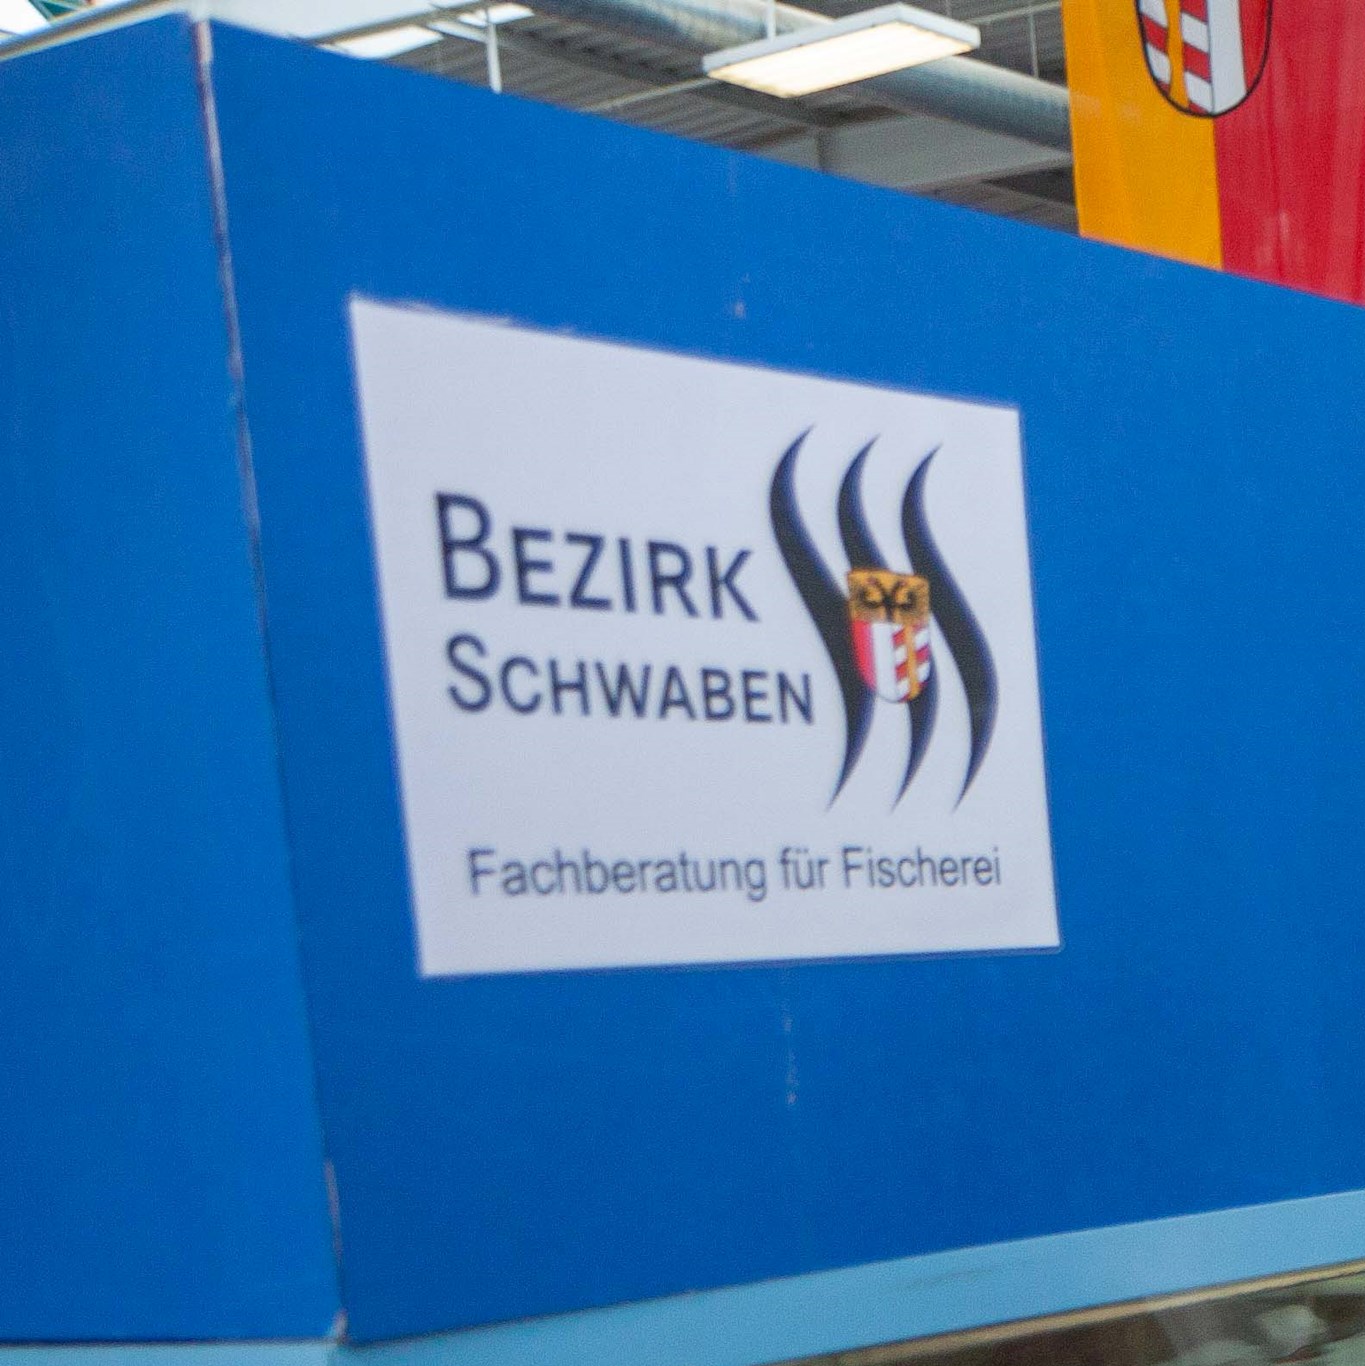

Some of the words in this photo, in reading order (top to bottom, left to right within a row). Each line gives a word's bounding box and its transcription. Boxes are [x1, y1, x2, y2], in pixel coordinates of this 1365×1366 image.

[434, 492, 757, 621] BEZIRK
[446, 633, 814, 724] SCHWABEN
[467, 845, 766, 902] Fachberatung
[780, 846, 827, 890] für
[841, 846, 1001, 888] Fischerei
